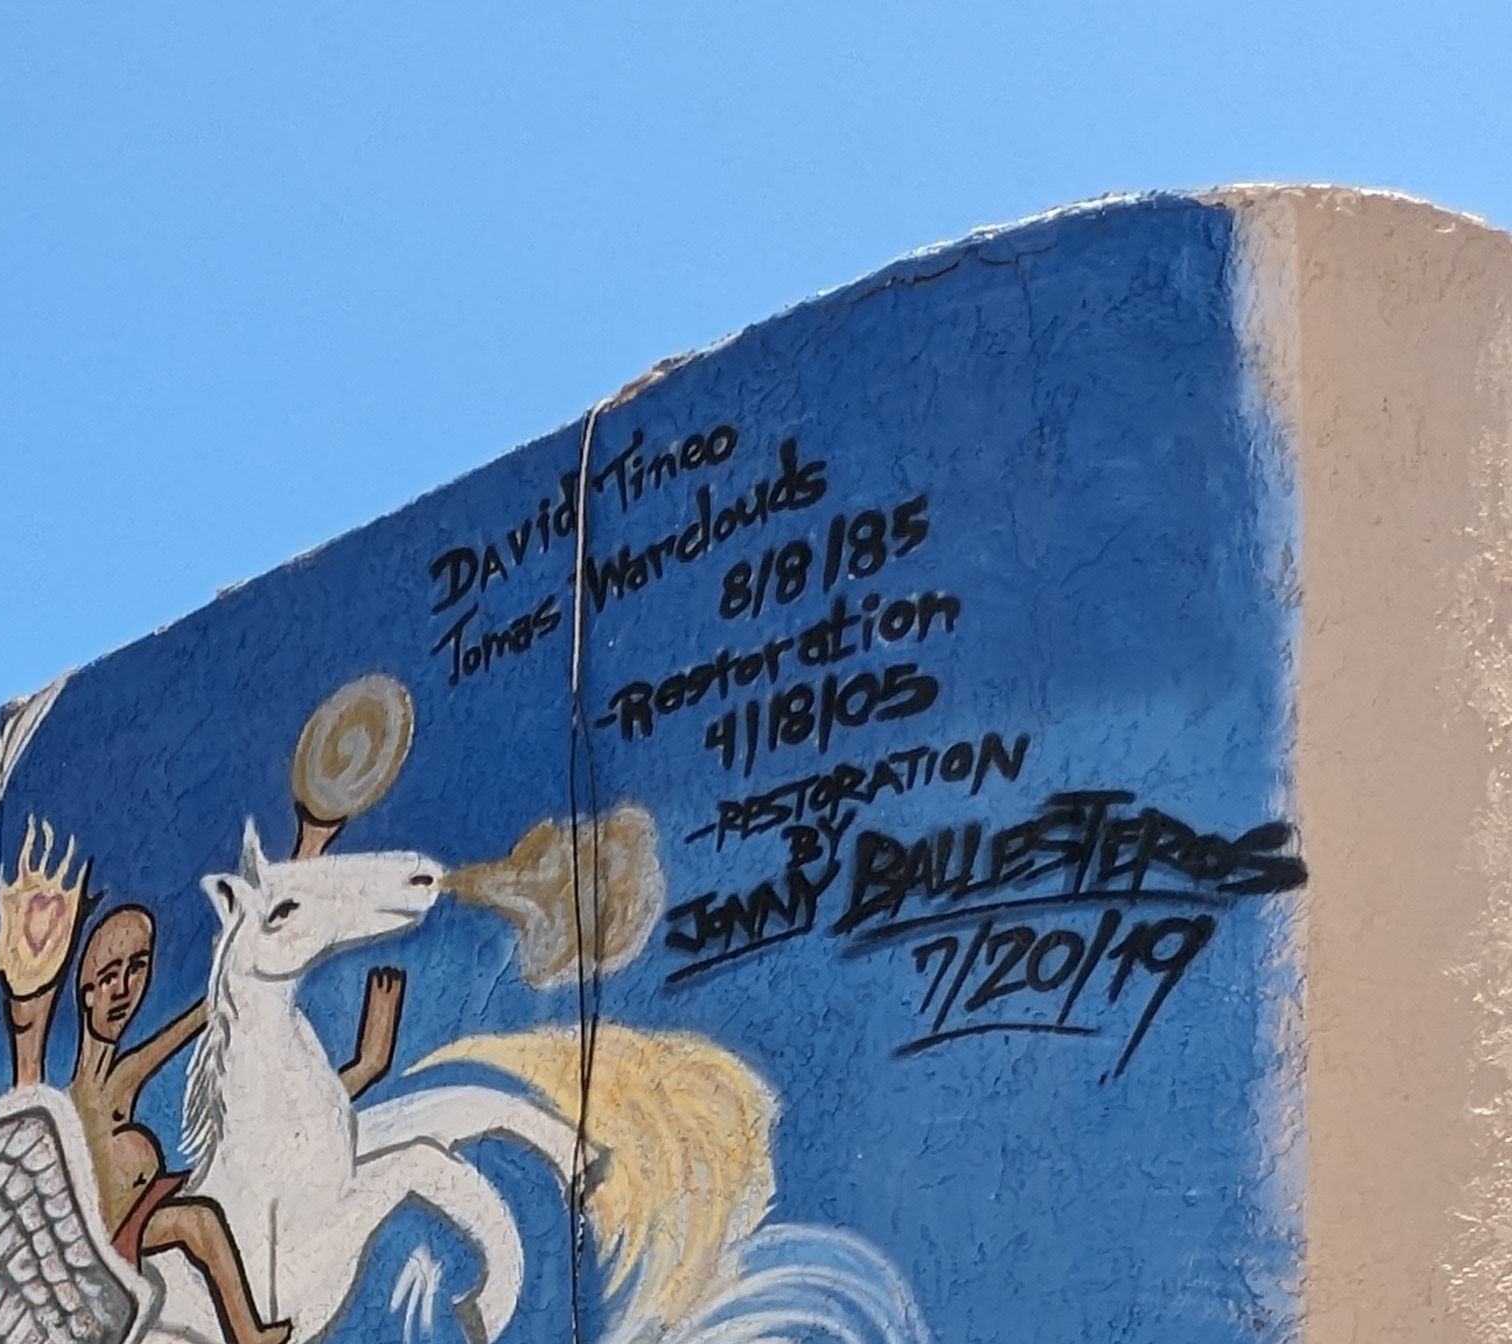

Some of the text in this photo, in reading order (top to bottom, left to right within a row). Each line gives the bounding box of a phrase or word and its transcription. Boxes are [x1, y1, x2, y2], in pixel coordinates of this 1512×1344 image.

[593, 424, 737, 513] Tineo
[718, 494, 929, 620] 8/8/85
[430, 594, 561, 687] Tomas
[781, 808, 856, 868] BY
[912, 908, 1215, 1085] 7/20/19
